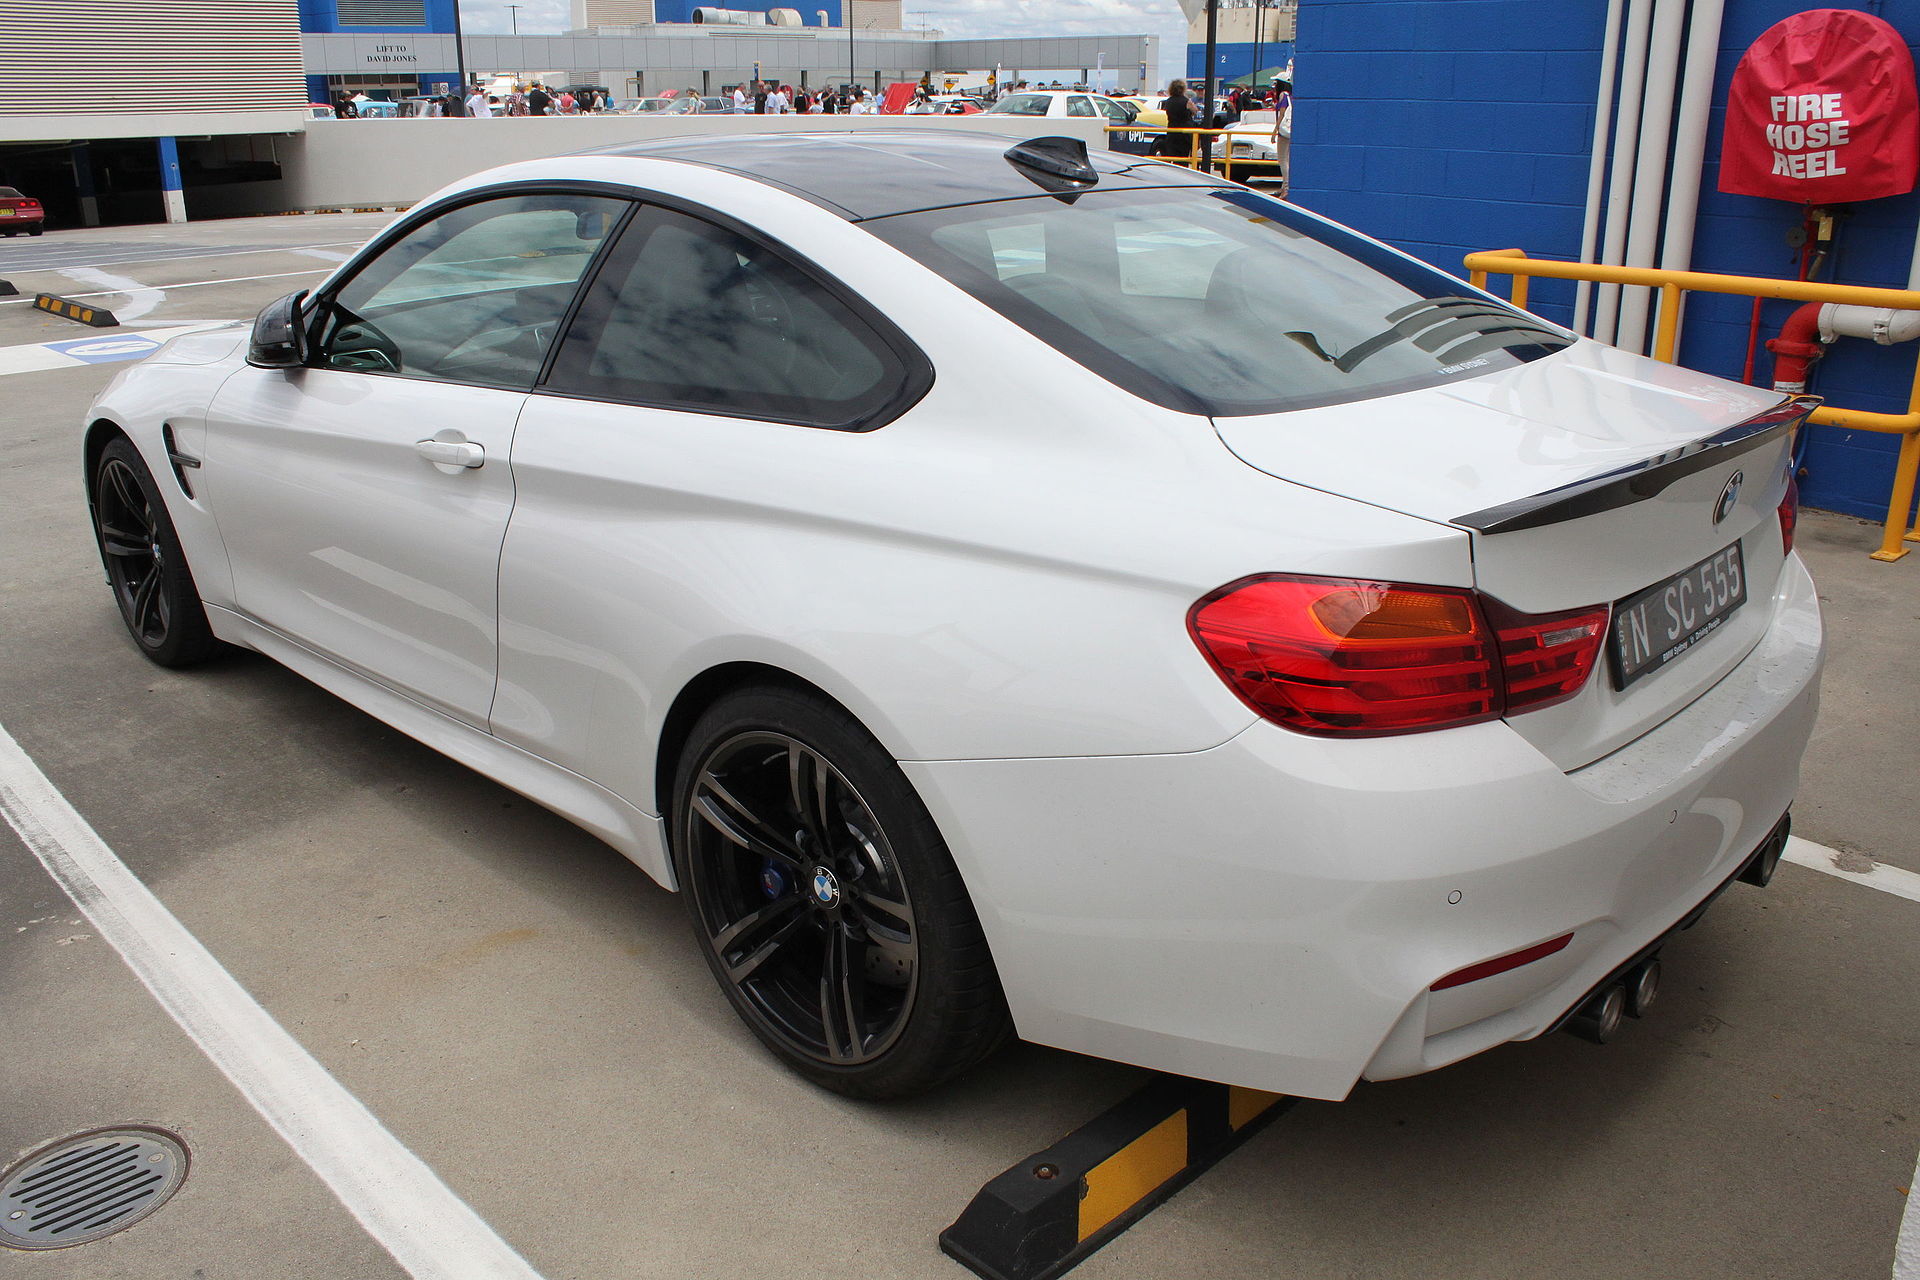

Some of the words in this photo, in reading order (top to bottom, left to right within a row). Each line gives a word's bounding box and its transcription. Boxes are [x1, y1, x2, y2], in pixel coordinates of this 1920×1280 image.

[376, 45, 393, 53] LIFT
[395, 45, 406, 53] TO
[1220, 55, 1227, 64] 2
[1770, 93, 1842, 122] FIRE
[1766, 120, 1849, 150] HOSE
[1771, 149, 1846, 179] REEL
[1630, 603, 1650, 664] N
[1664, 577, 1695, 640] SC
[1700, 545, 1740, 616] 555
